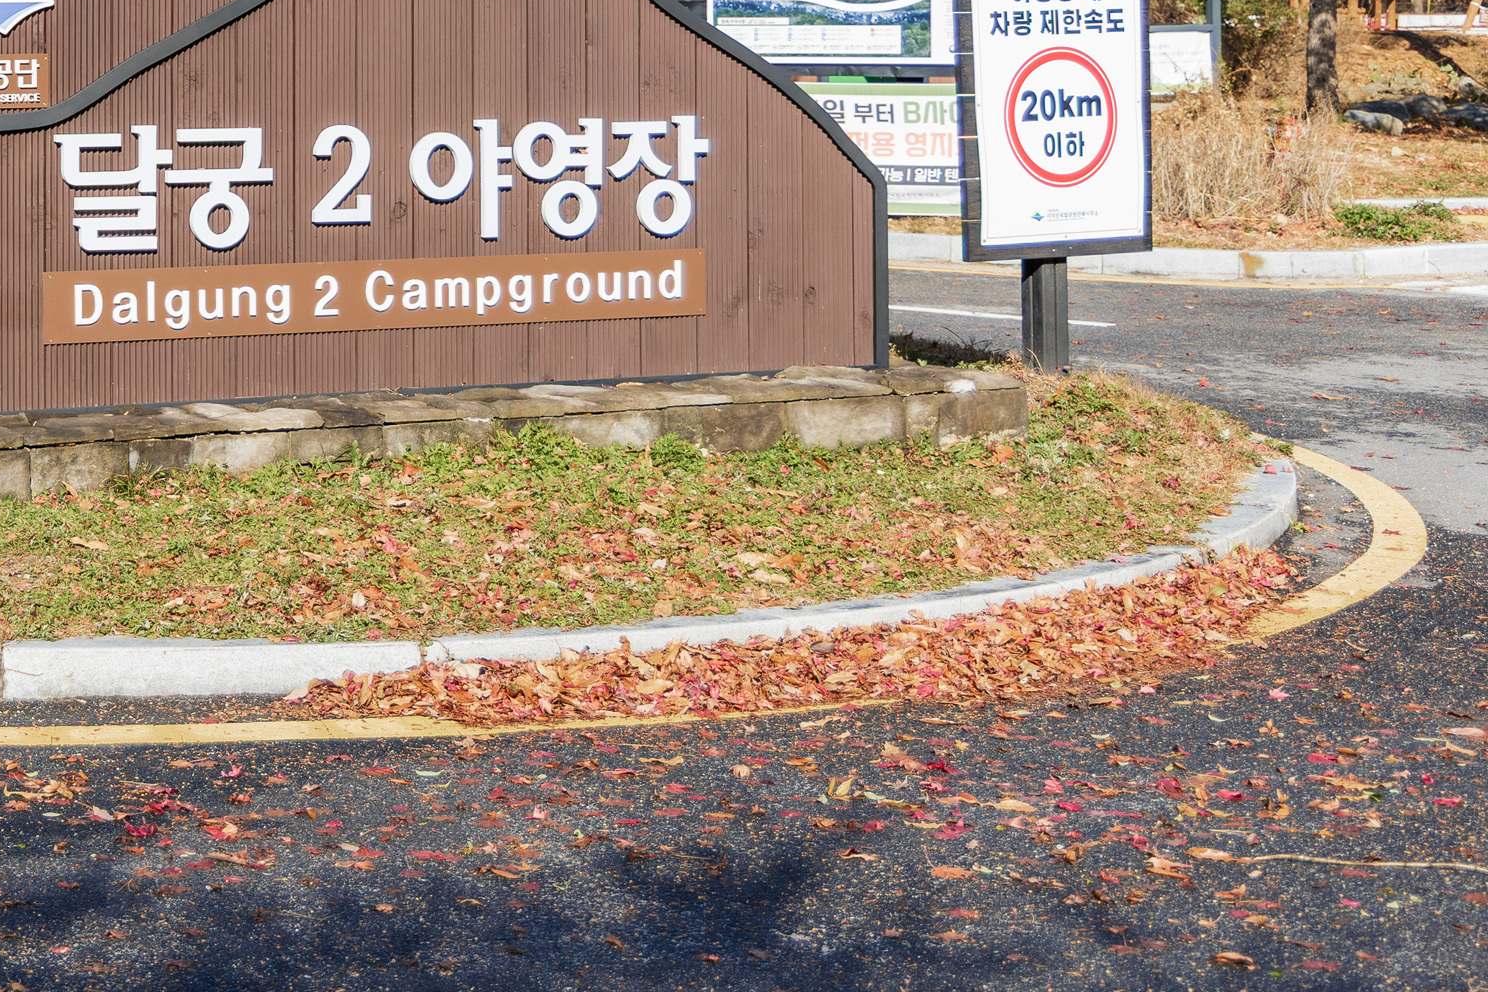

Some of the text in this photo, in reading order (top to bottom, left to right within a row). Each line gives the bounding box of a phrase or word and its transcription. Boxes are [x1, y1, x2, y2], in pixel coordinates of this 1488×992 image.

[990, 8, 1125, 36] 차량 제한속도
[0, 93, 40, 104] SERVICE
[815, 99, 845, 124] 일
[854, 103, 895, 124] 부터
[1021, 88, 1102, 122] 20km
[905, 132, 959, 158] 영지
[1043, 131, 1085, 158] 이하
[53, 115, 710, 254] 달궁 2 야영장
[914, 167, 942, 182] 일반
[74, 260, 682, 330] Dalgung 2 Campground
